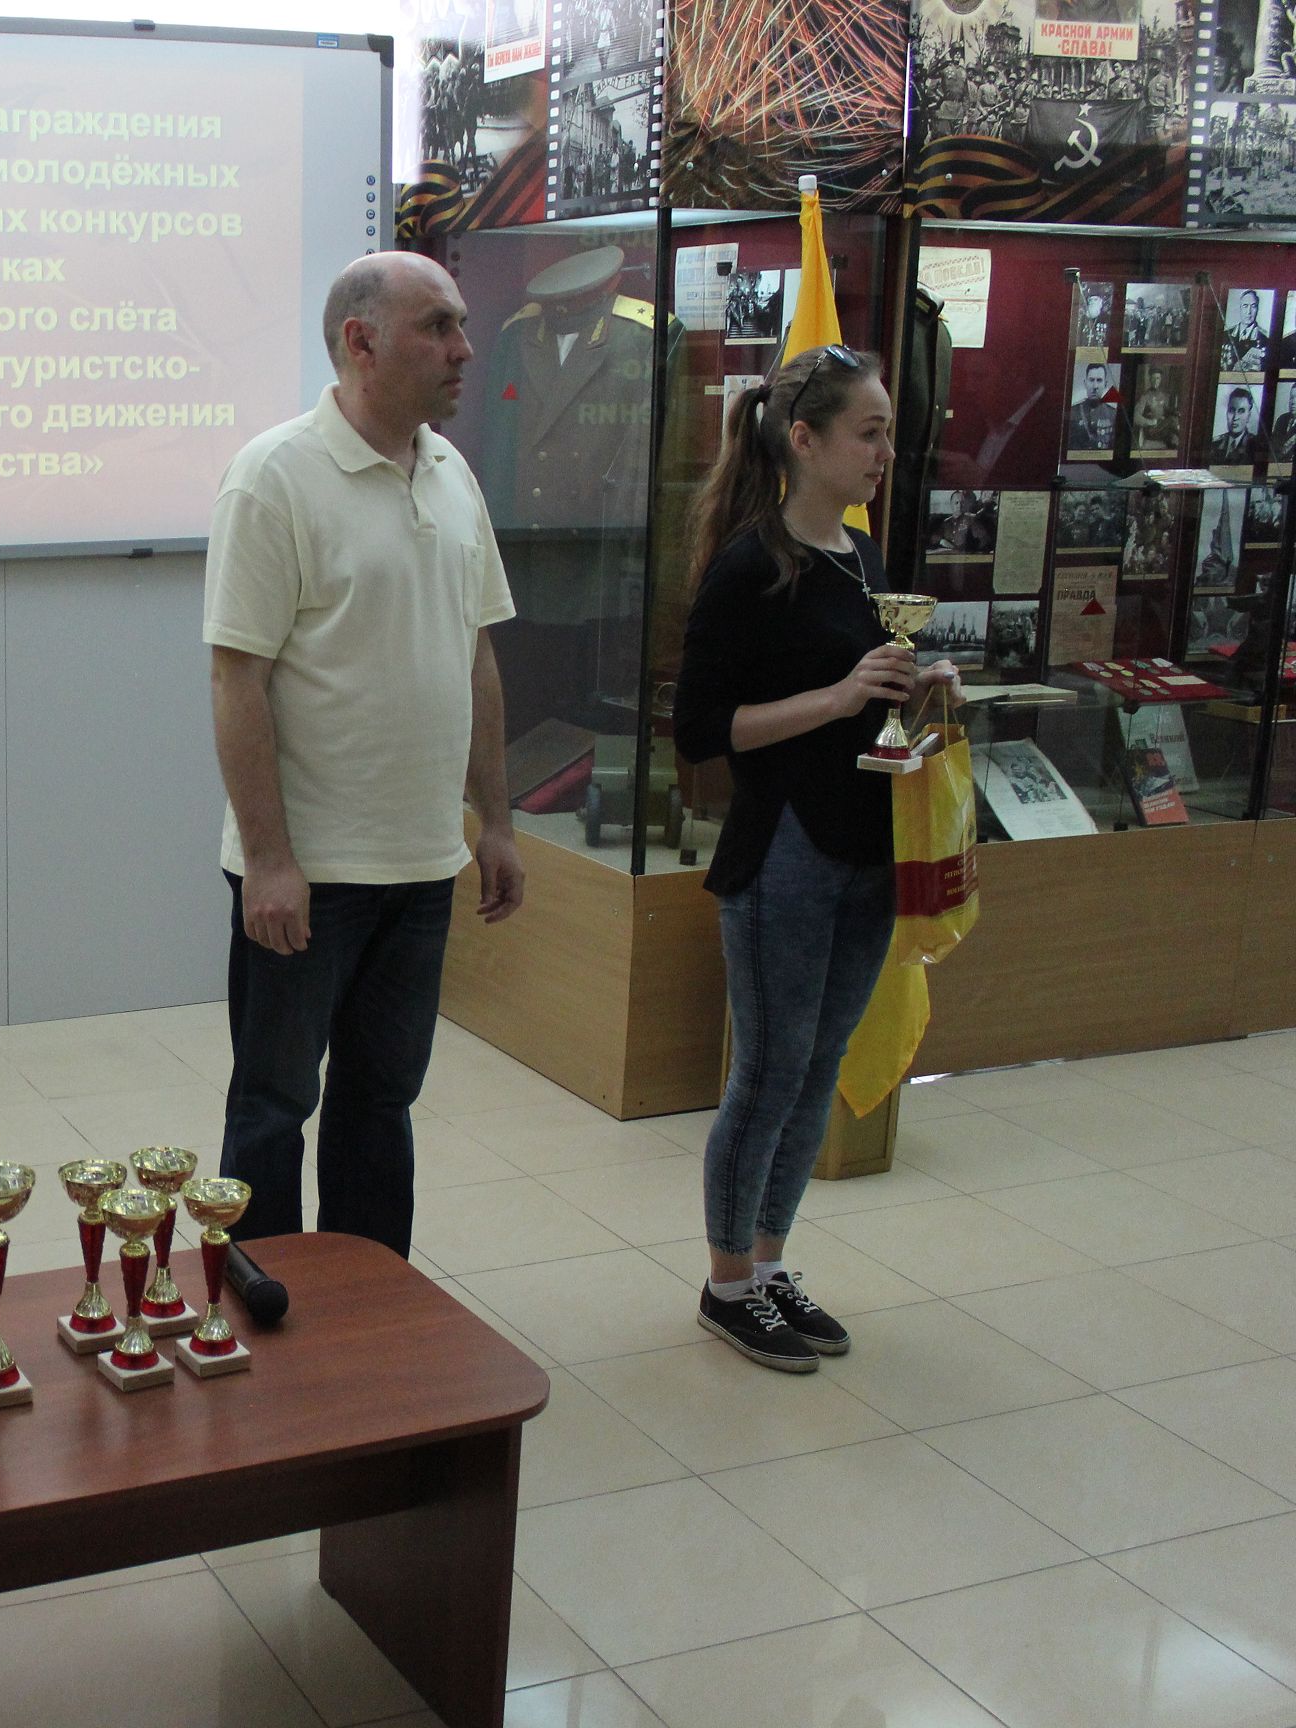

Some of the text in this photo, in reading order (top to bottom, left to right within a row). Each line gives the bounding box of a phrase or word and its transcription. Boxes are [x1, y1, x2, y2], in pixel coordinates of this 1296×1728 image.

[1041, 23, 1133, 41] КРАСНОЙ АРМИИ
[1061, 40, 1113, 57] СЛАВА!
[40, 209, 242, 243] конкурсов
[69, 302, 177, 332] слёта
[42, 402, 236, 433] движения
